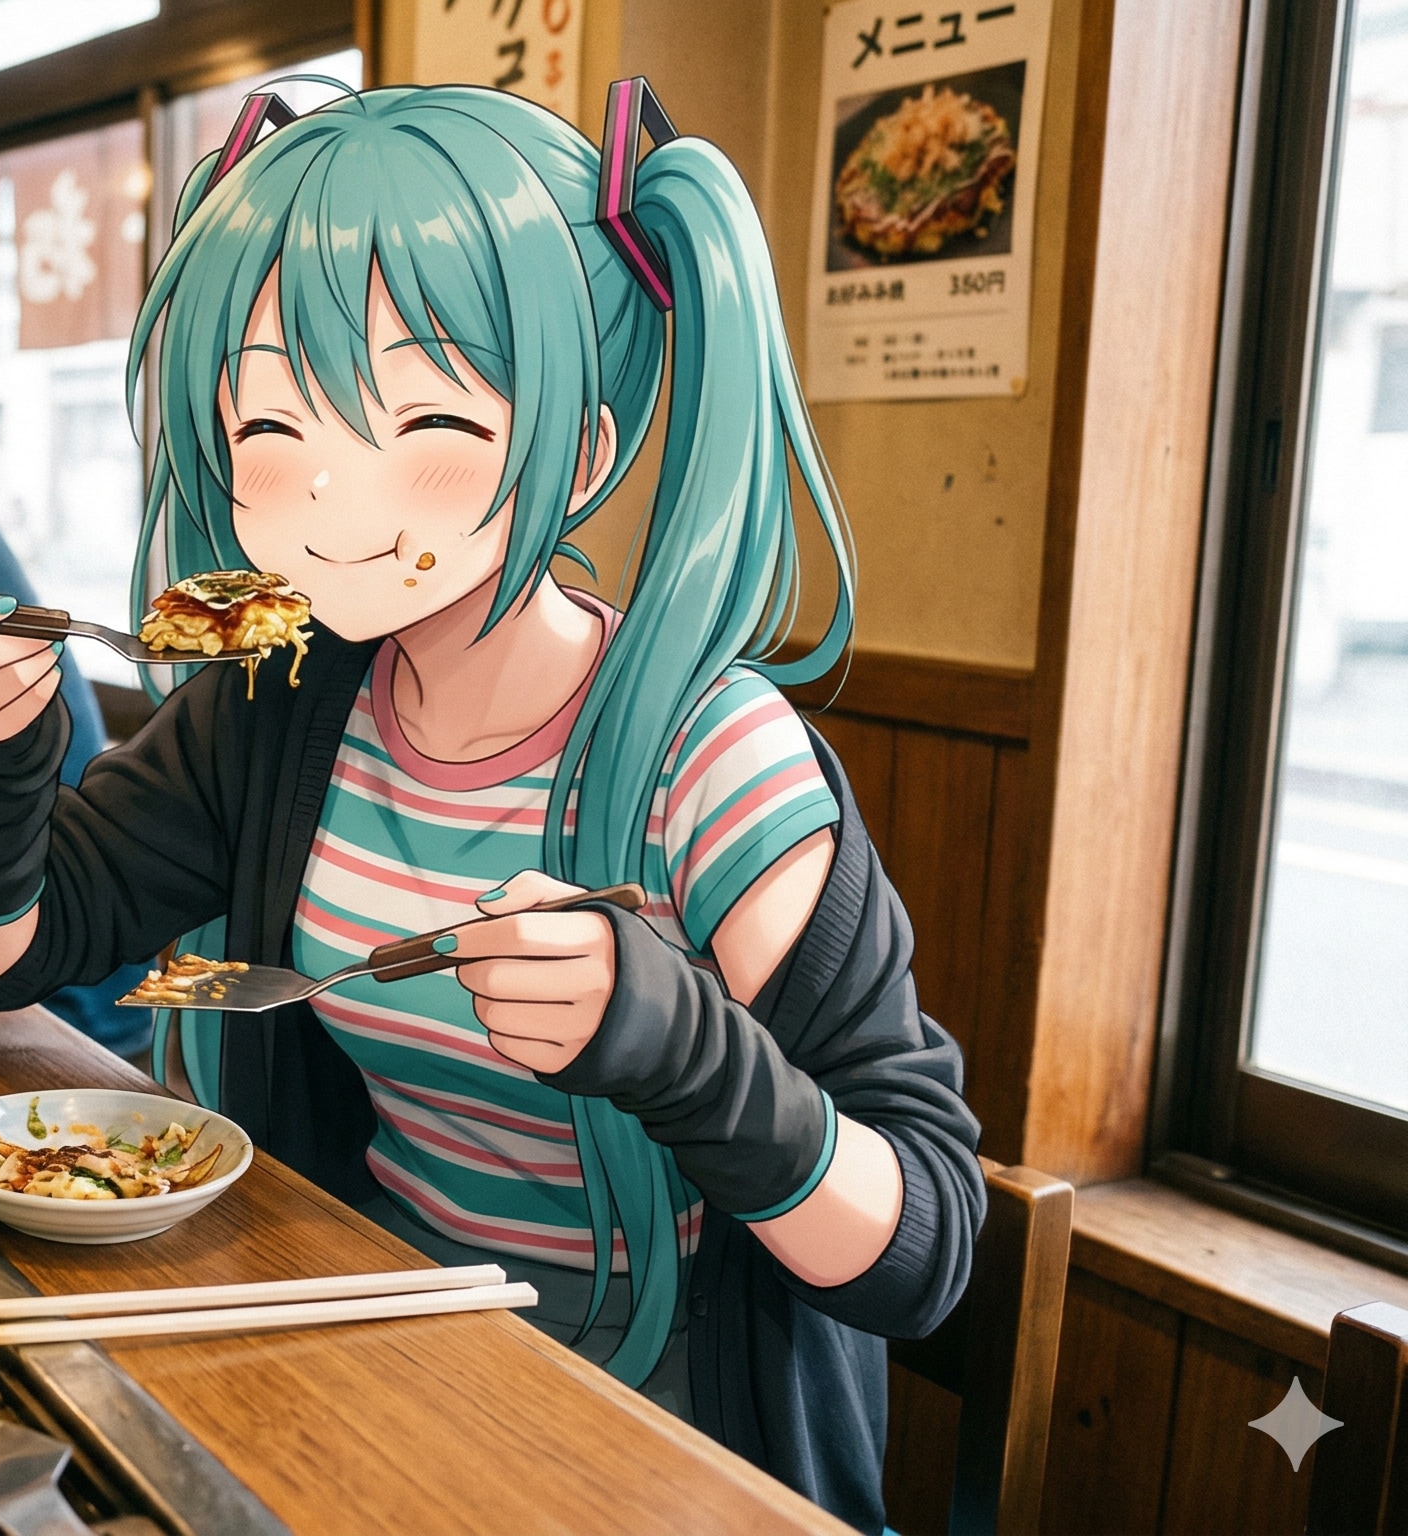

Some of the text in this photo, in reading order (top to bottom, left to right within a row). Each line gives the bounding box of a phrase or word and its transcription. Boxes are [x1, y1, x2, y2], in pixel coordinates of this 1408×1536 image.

[851, 4, 1016, 69] メニュー
[949, 270, 1006, 297] 350円
